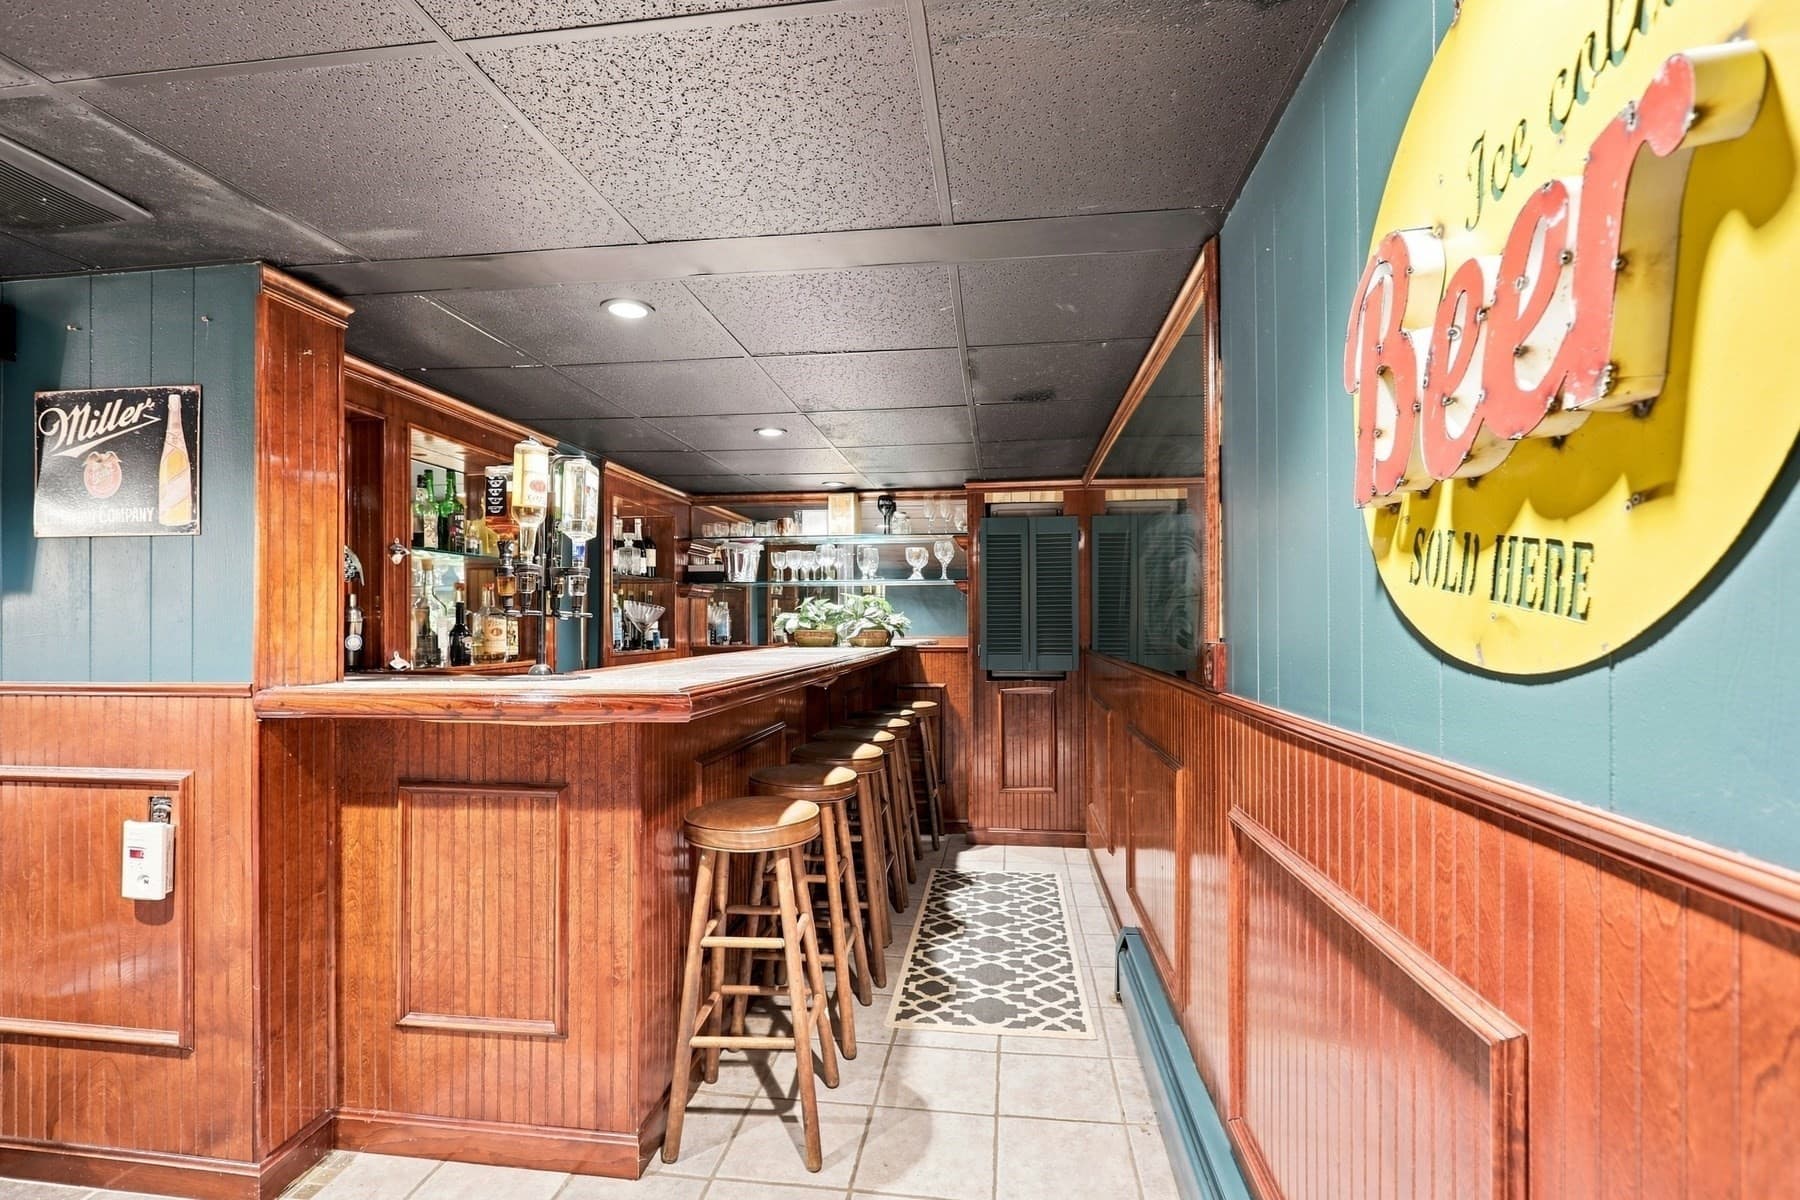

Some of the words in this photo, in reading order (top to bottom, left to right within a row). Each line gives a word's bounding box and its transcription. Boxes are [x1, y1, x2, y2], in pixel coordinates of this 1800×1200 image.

[1464, 118, 1533, 233] Ice
[1549, 0, 1674, 135] col
[1343, 53, 1697, 509] Beer
[1409, 527, 1480, 596] SOLD
[1490, 535, 1595, 622] HERE
